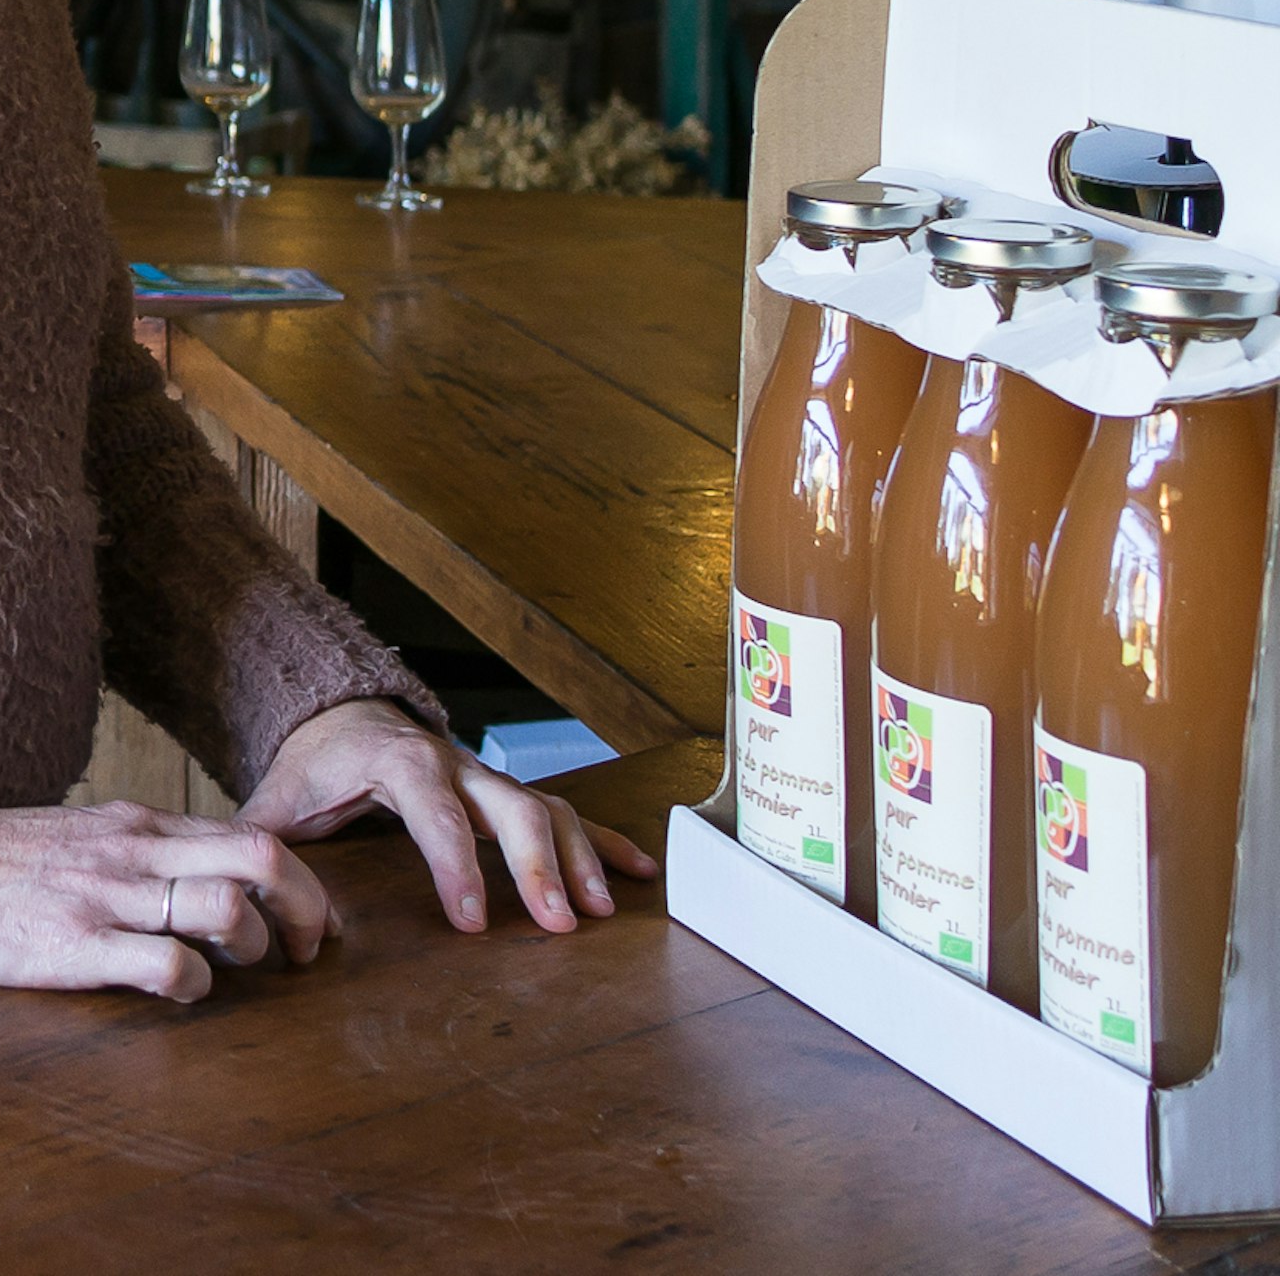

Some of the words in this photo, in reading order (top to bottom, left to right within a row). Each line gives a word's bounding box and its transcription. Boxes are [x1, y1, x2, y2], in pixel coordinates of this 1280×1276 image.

[748, 717, 779, 743] pur
[760, 763, 834, 796] pomme
[885, 800, 918, 829] pur
[896, 850, 975, 891] pomme
[1044, 869, 1075, 899] pur
[1056, 923, 1136, 966] pomme
